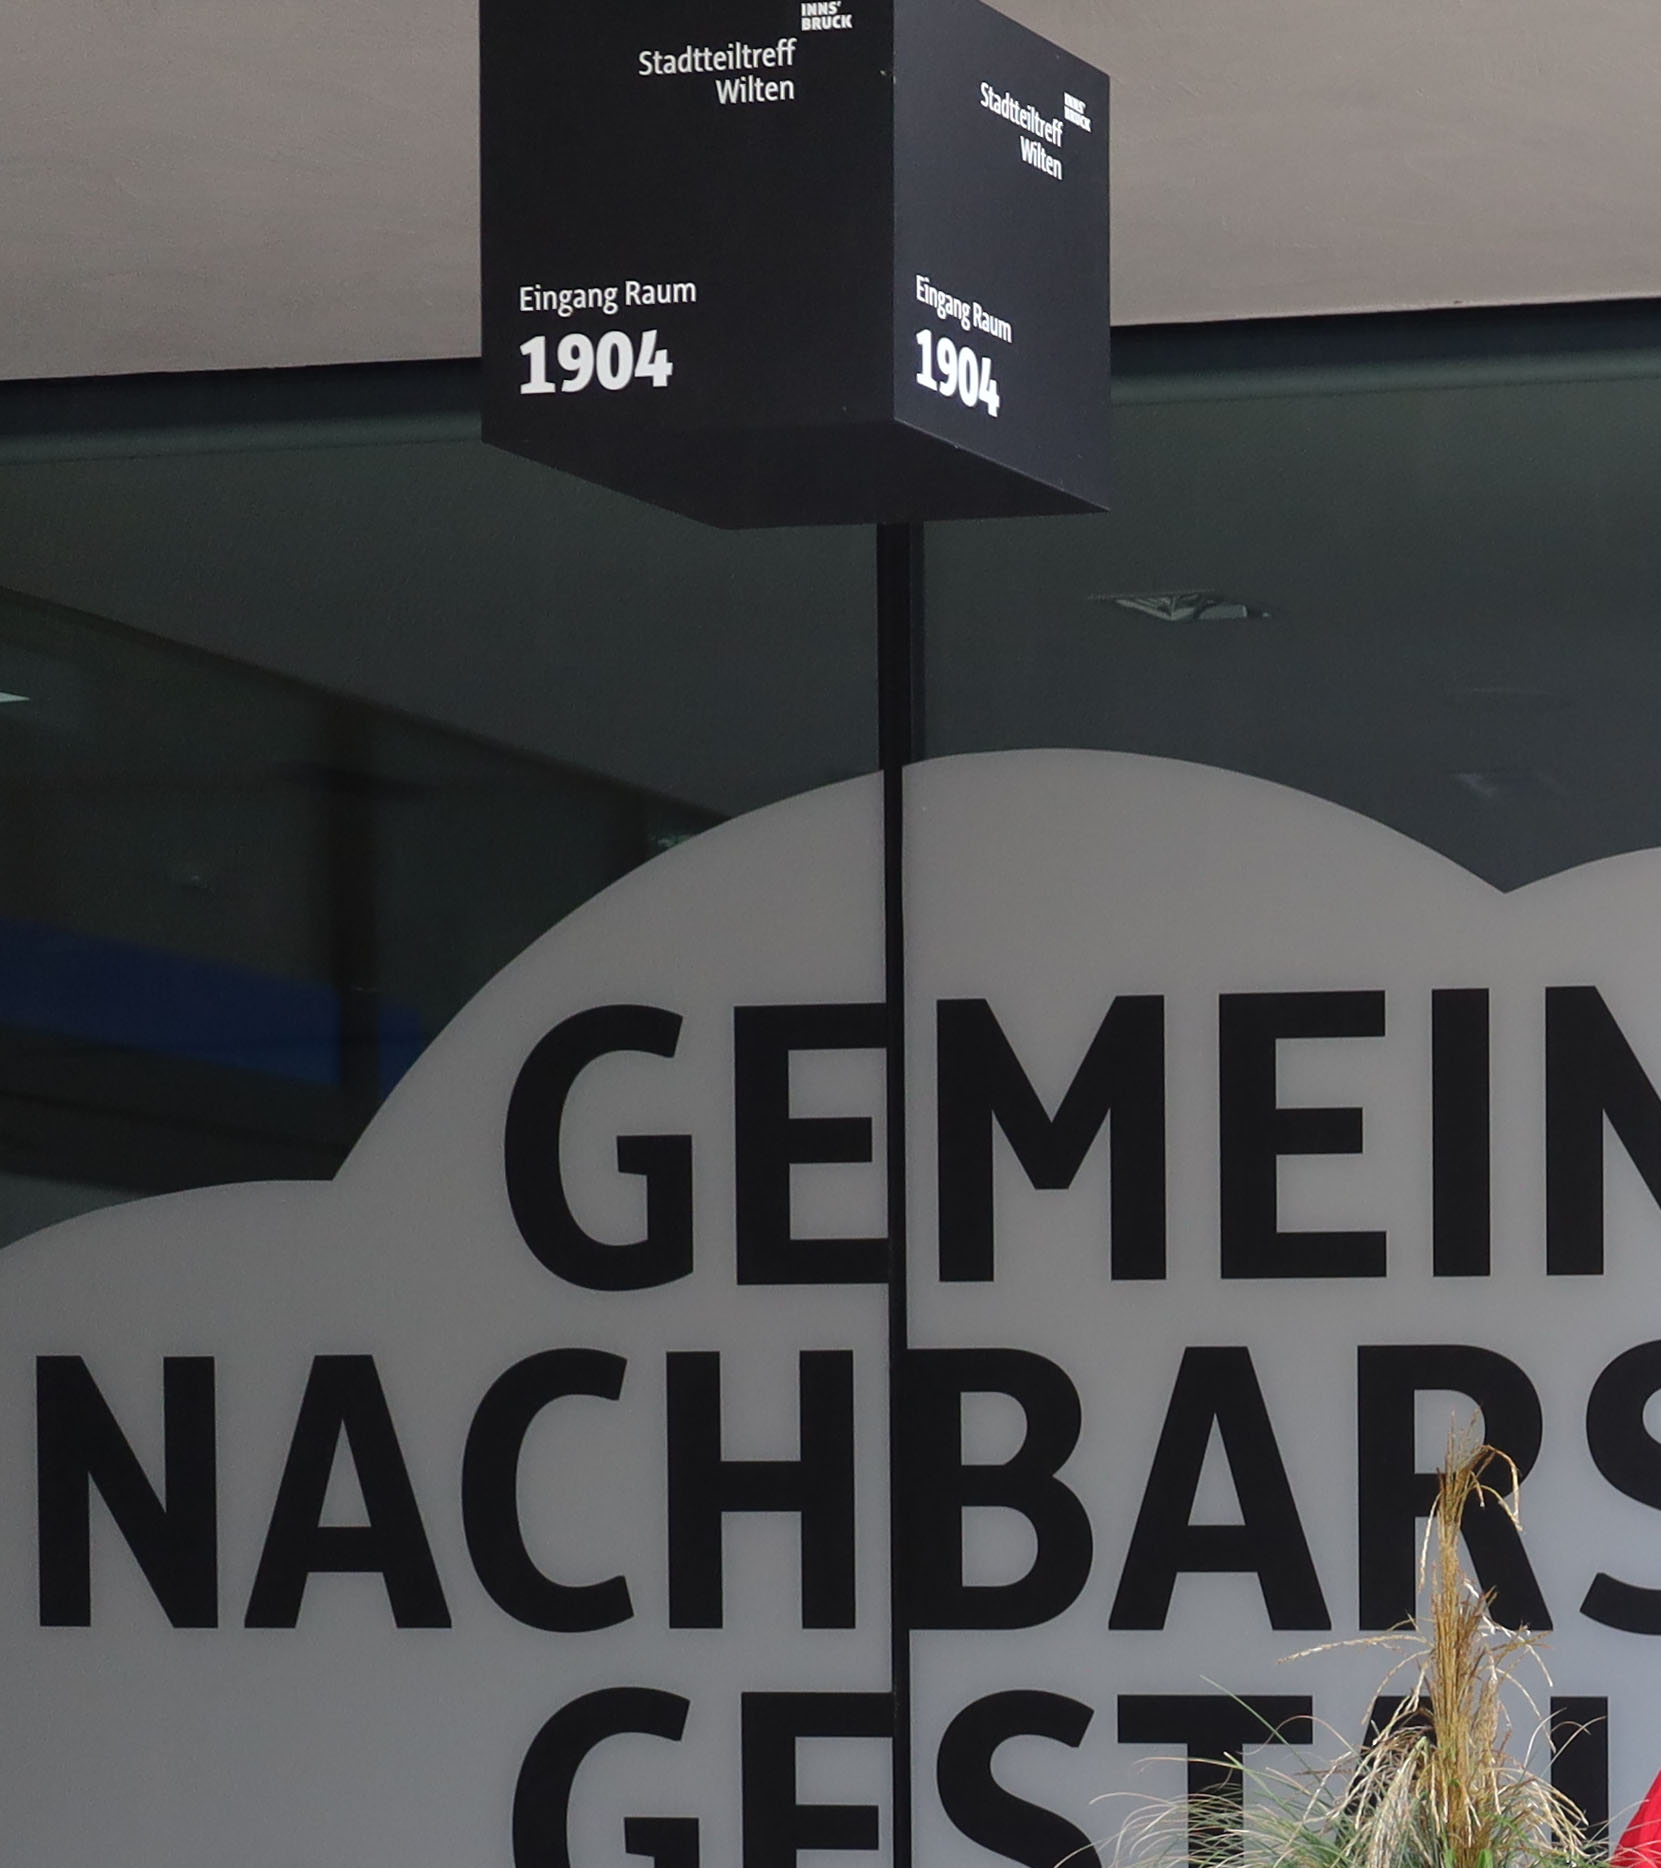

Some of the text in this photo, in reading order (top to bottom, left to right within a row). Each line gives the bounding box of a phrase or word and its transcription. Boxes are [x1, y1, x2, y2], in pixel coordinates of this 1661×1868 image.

[801, 14, 852, 31] BRUCK
[638, 37, 797, 76] Stadtteiltreff
[715, 76, 795, 104] Wilten
[980, 82, 1063, 147] Stadtteiltreff
[1020, 135, 1062, 180] Wilten
[520, 280, 697, 318] Eingang Raum
[916, 274, 1013, 344] Eingang Raum
[519, 329, 674, 395] 1904
[915, 328, 1000, 418] 1904
